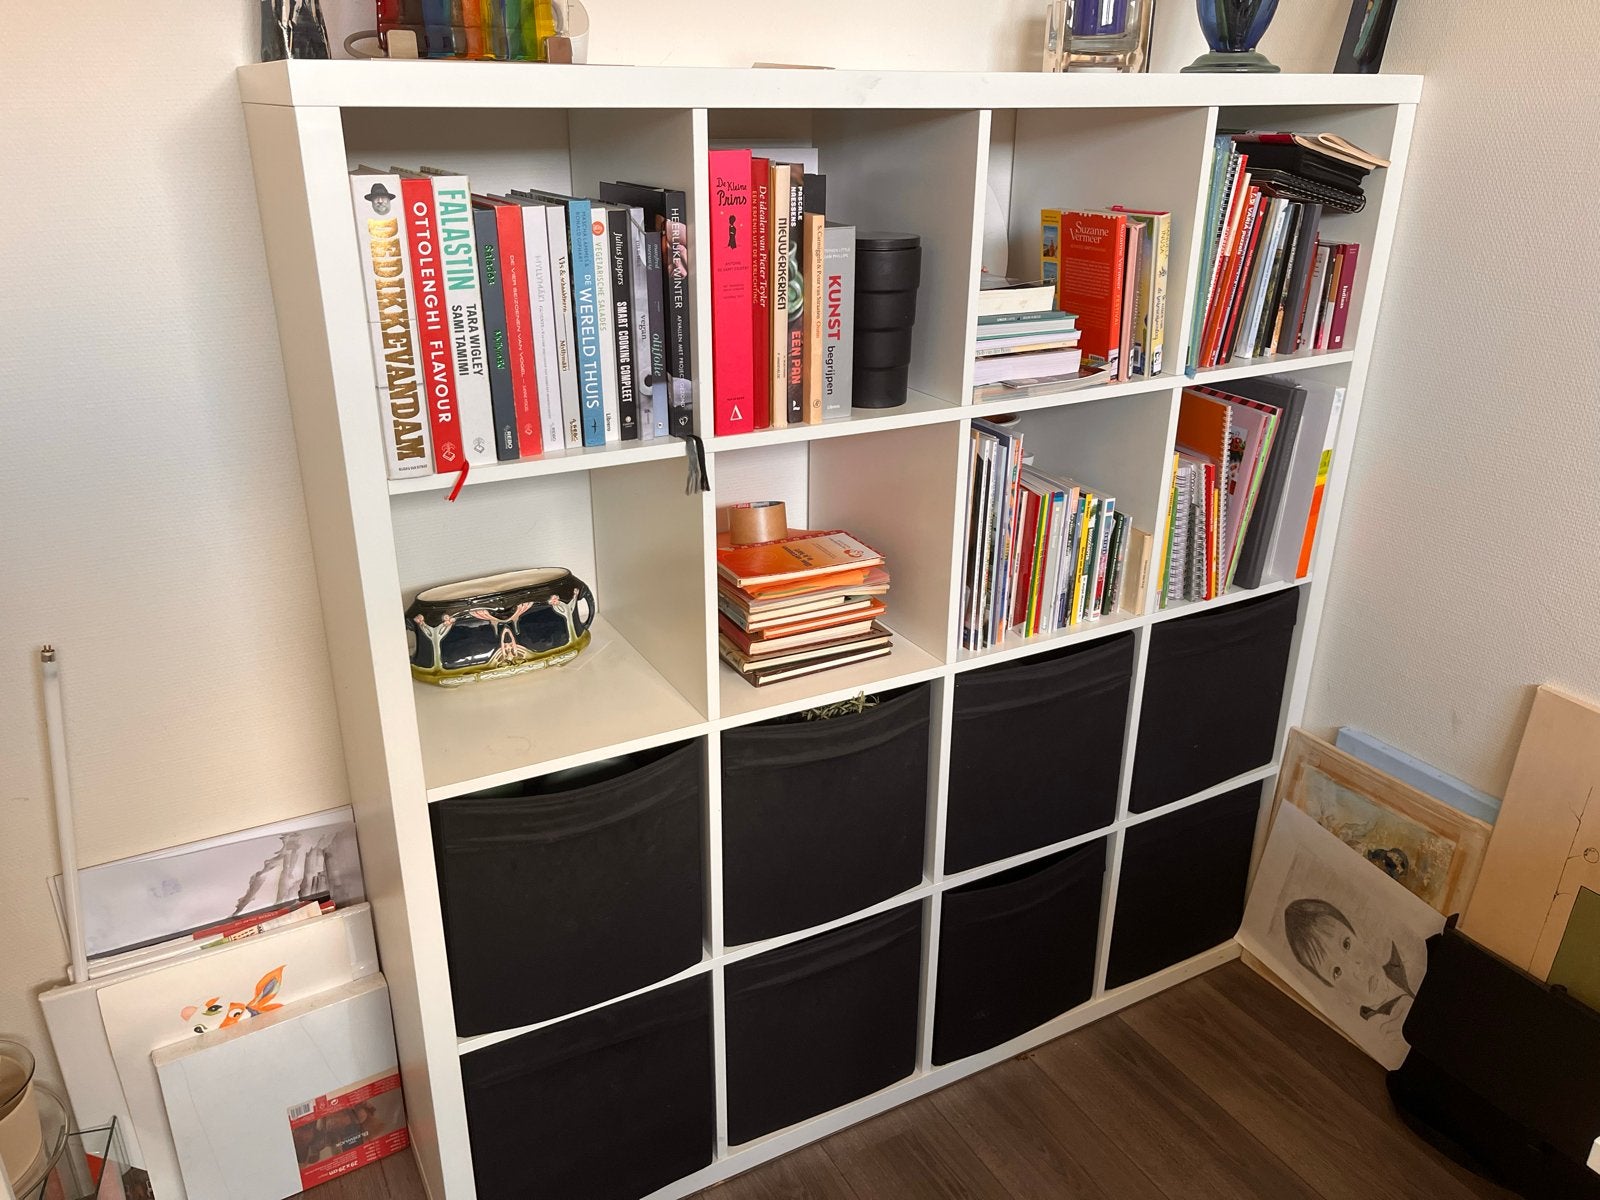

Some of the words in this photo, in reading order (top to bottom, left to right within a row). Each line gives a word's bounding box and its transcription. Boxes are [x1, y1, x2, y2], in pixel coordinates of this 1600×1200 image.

[716, 190, 747, 206] Prins
[759, 186, 767, 199] De
[759, 200, 768, 233] idealen
[1075, 221, 1109, 236] Suzanne
[1242, 207, 1253, 230] VARIA
[438, 190, 476, 290] FALASTIN
[613, 232, 624, 255] Julius
[671, 208, 682, 264] HEERLIJKE
[1070, 228, 1102, 244] Vermeer
[1235, 230, 1247, 254] puzzels
[510, 255, 515, 265] DE
[595, 242, 604, 296] VEGETARISCHE
[615, 256, 625, 285] Jaspers
[760, 254, 768, 279] Pieter
[778, 218, 787, 310] NIEUWERKERKEN
[584, 274, 591, 285] DE
[673, 267, 683, 308] WINTER
[758, 280, 768, 308] Teyler
[412, 202, 441, 330] OTTOLENGHI
[430, 340, 452, 423] FLAVOUR
[452, 305, 463, 334] SAMI
[466, 304, 478, 334] TARA
[512, 287, 522, 332] SEIZOENEN
[579, 287, 597, 357] WERELD
[598, 299, 607, 331] SALADES
[616, 301, 630, 328] SMART
[827, 275, 842, 341] KUNST
[368, 216, 426, 461] DEDIKKEVANDAM
[639, 315, 648, 340] vegan
[790, 331, 802, 355] ÉÉN
[454, 335, 469, 376] TAMIMI
[469, 336, 484, 376] WIGLEY
[618, 330, 631, 363] COOKING
[652, 333, 664, 377] olijfolie
[518, 352, 528, 377] VOGEL
[791, 358, 801, 384] PAN
[826, 345, 836, 395] begrijpen
[584, 361, 599, 408] THUIS
[620, 365, 633, 402] COMPLEET
